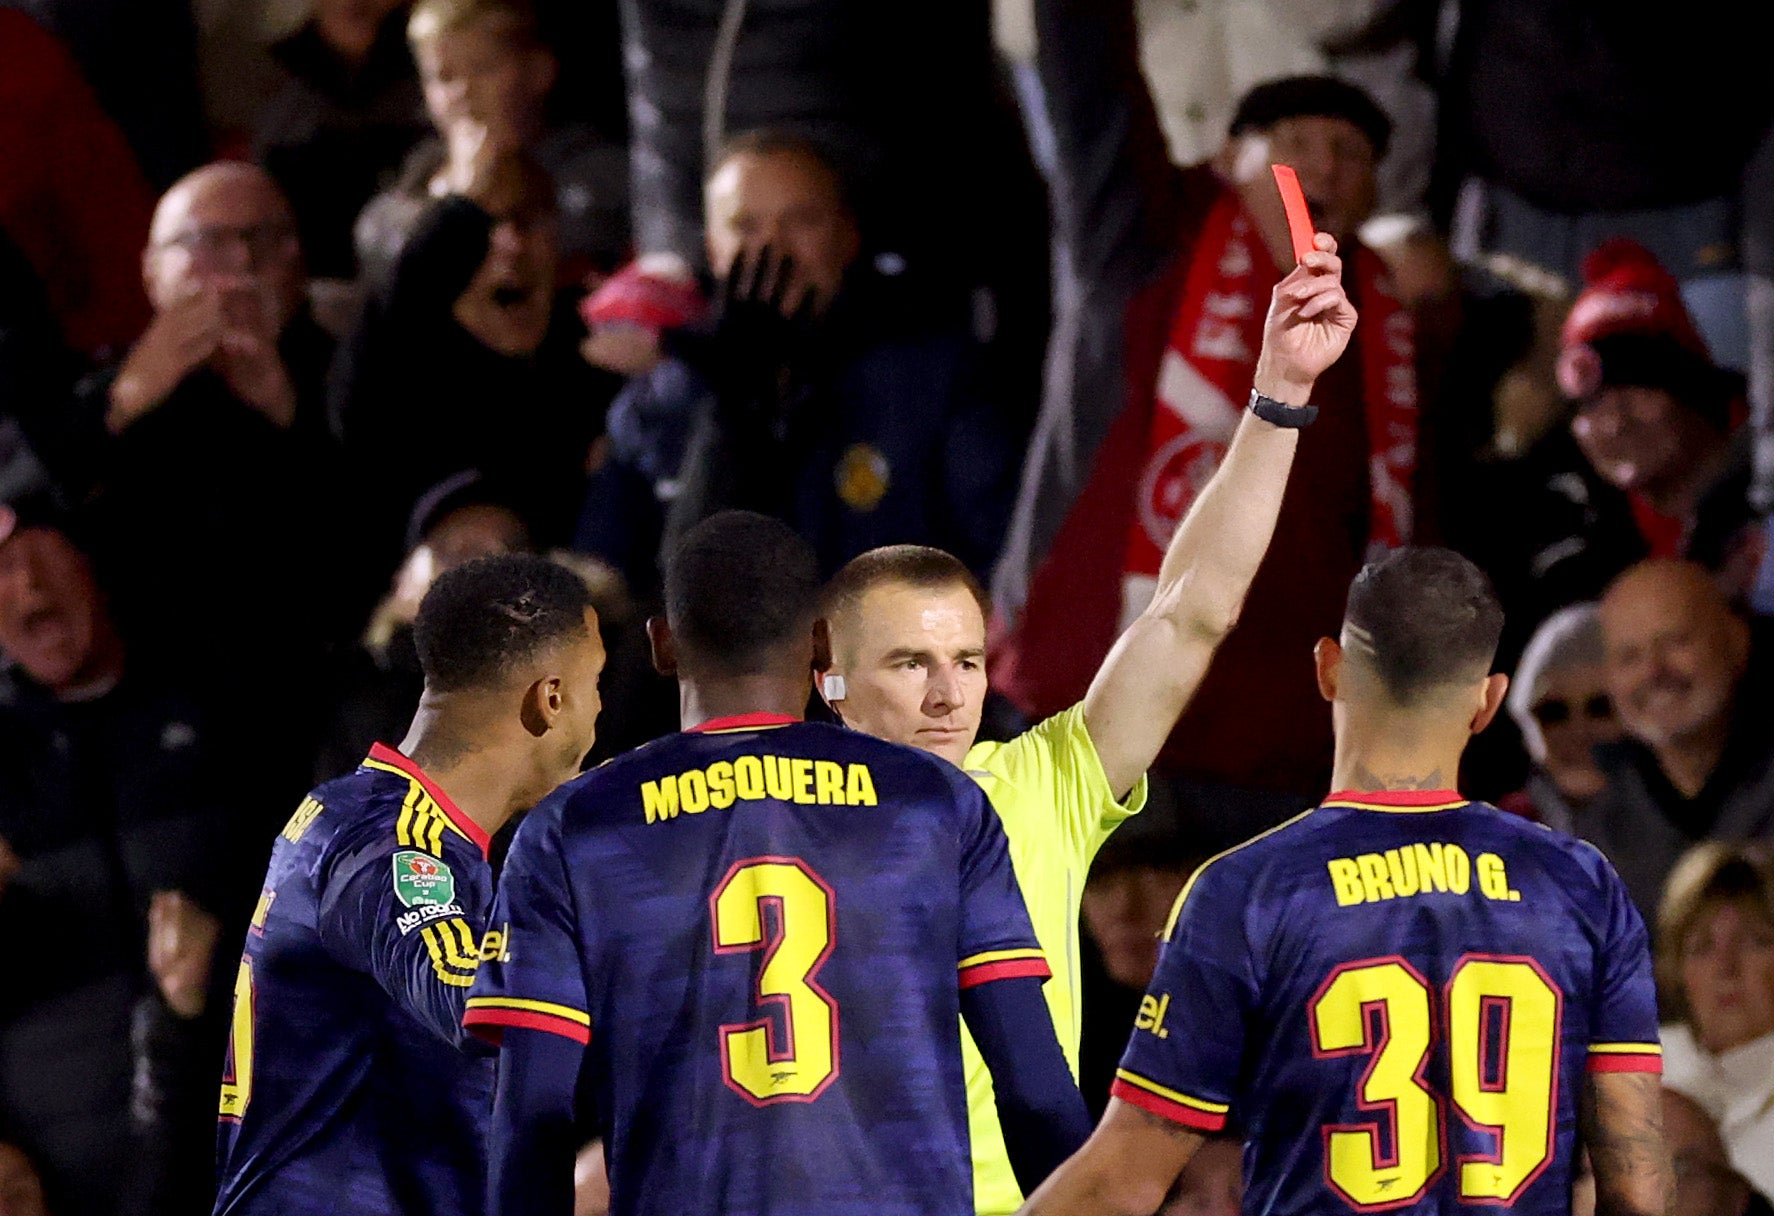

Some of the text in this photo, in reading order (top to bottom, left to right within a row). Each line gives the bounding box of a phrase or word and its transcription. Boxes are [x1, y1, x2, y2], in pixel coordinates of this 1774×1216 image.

[640, 755, 878, 824] MOSQUERA
[413, 881, 436, 889] Cup
[1327, 842, 1521, 907] BRUNO G.
[396, 912, 420, 930] No
[479, 922, 511, 963] el.
[708, 855, 841, 1108] 3
[1134, 993, 1170, 1039] el.
[1308, 953, 1562, 1213] 39
